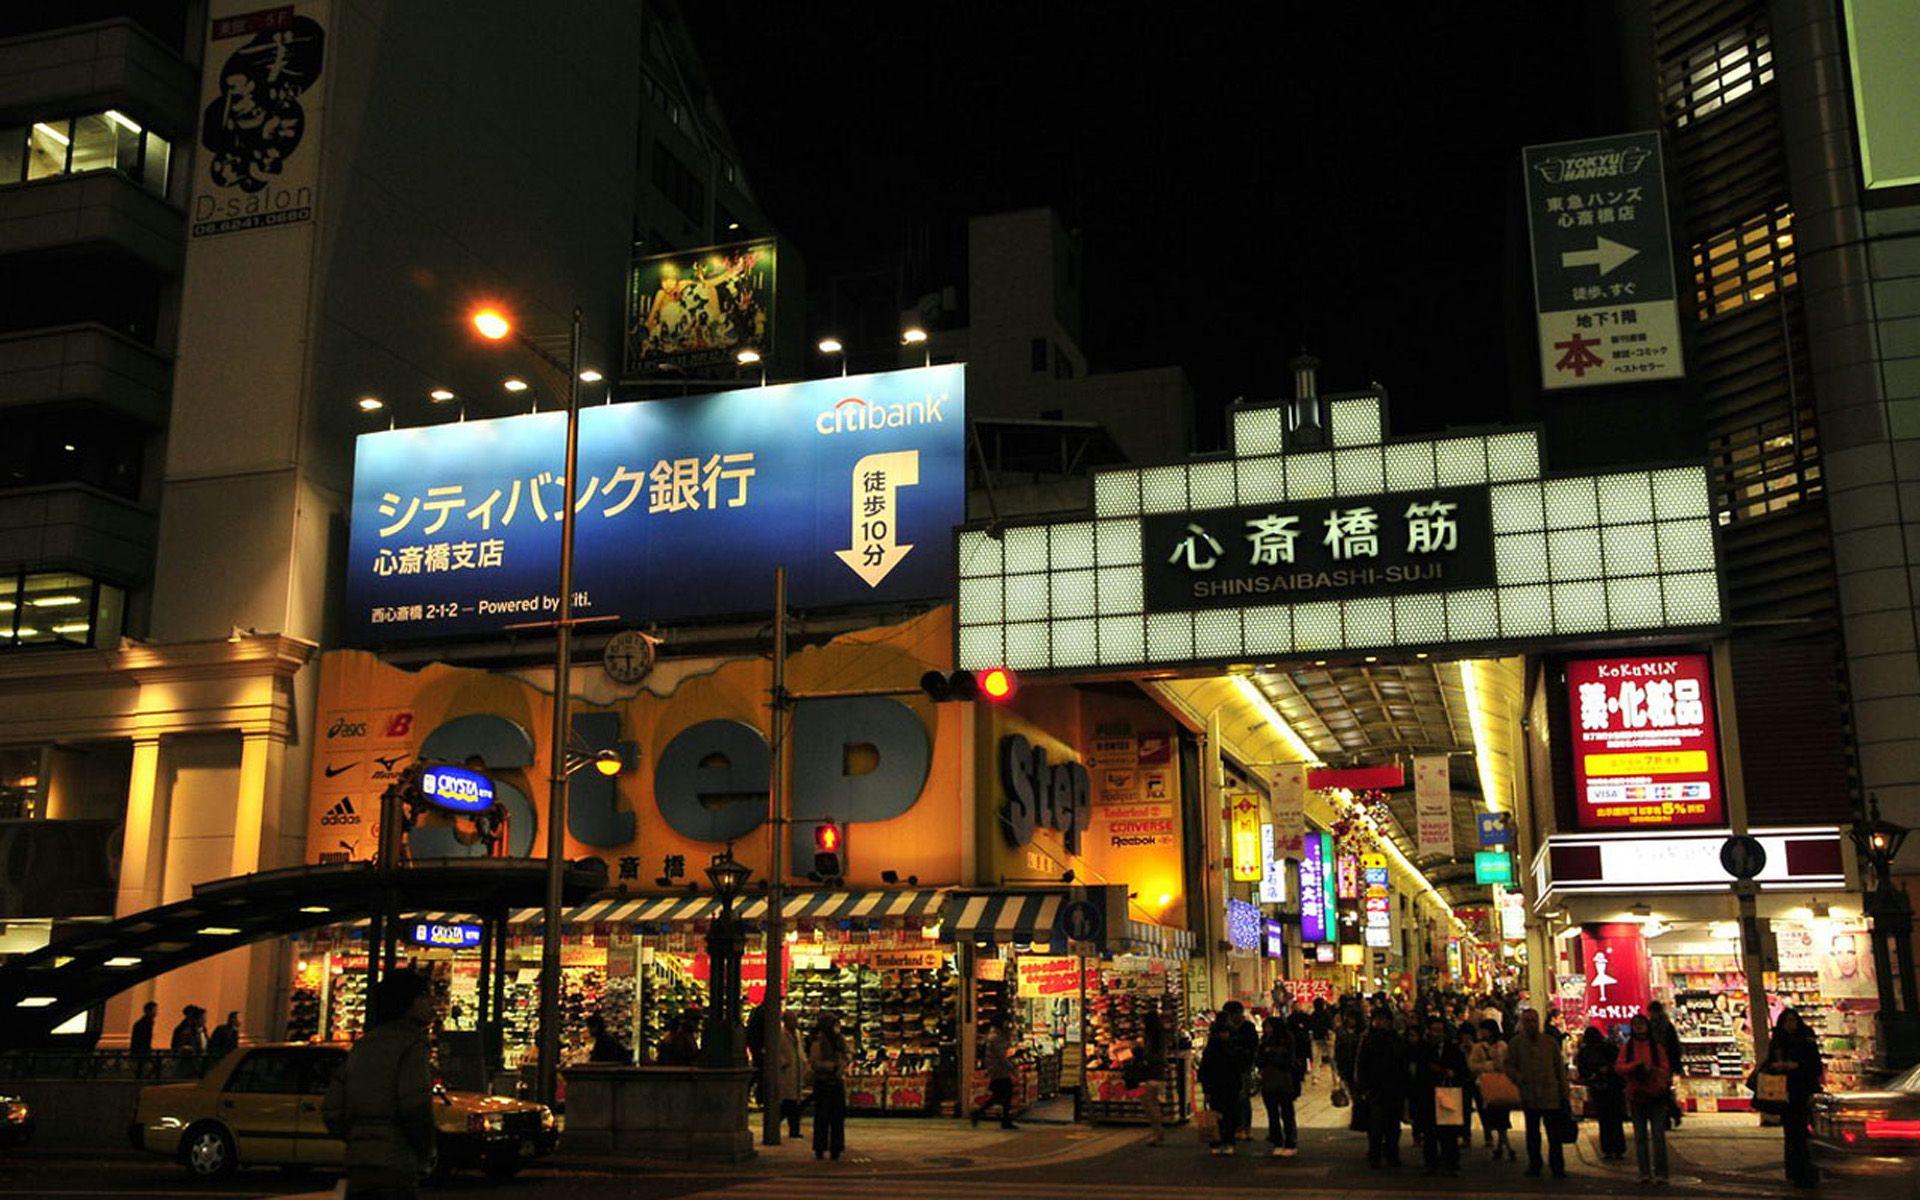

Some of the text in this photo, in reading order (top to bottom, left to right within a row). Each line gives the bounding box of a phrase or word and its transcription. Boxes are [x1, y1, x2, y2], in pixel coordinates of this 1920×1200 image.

[1565, 153, 1620, 170] TOKYU
[196, 187, 312, 221] D-salon
[1546, 187, 1643, 213] 東急ハンズ
[1558, 206, 1636, 228] 心斎橋店
[1576, 310, 1637, 328] 地下1階
[1554, 333, 1604, 377] 本
[816, 394, 943, 434] citibank
[378, 452, 756, 538] シティバンク銀行
[1168, 500, 1458, 573] 心斎橋筋
[373, 538, 504, 577] 心斎橋支店
[1193, 563, 1443, 598] SHINSAIBASHI-SUJI
[371, 604, 423, 624] 西心斎橋
[426, 602, 458, 619] 2-1-2
[479, 597, 539, 615] Powered
[543, 596, 560, 614] by
[570, 592, 592, 608] iti.
[1579, 679, 1704, 730] 薬・化粧品
[321, 815, 360, 826] adidas
[1112, 836, 1156, 847] Reebok
